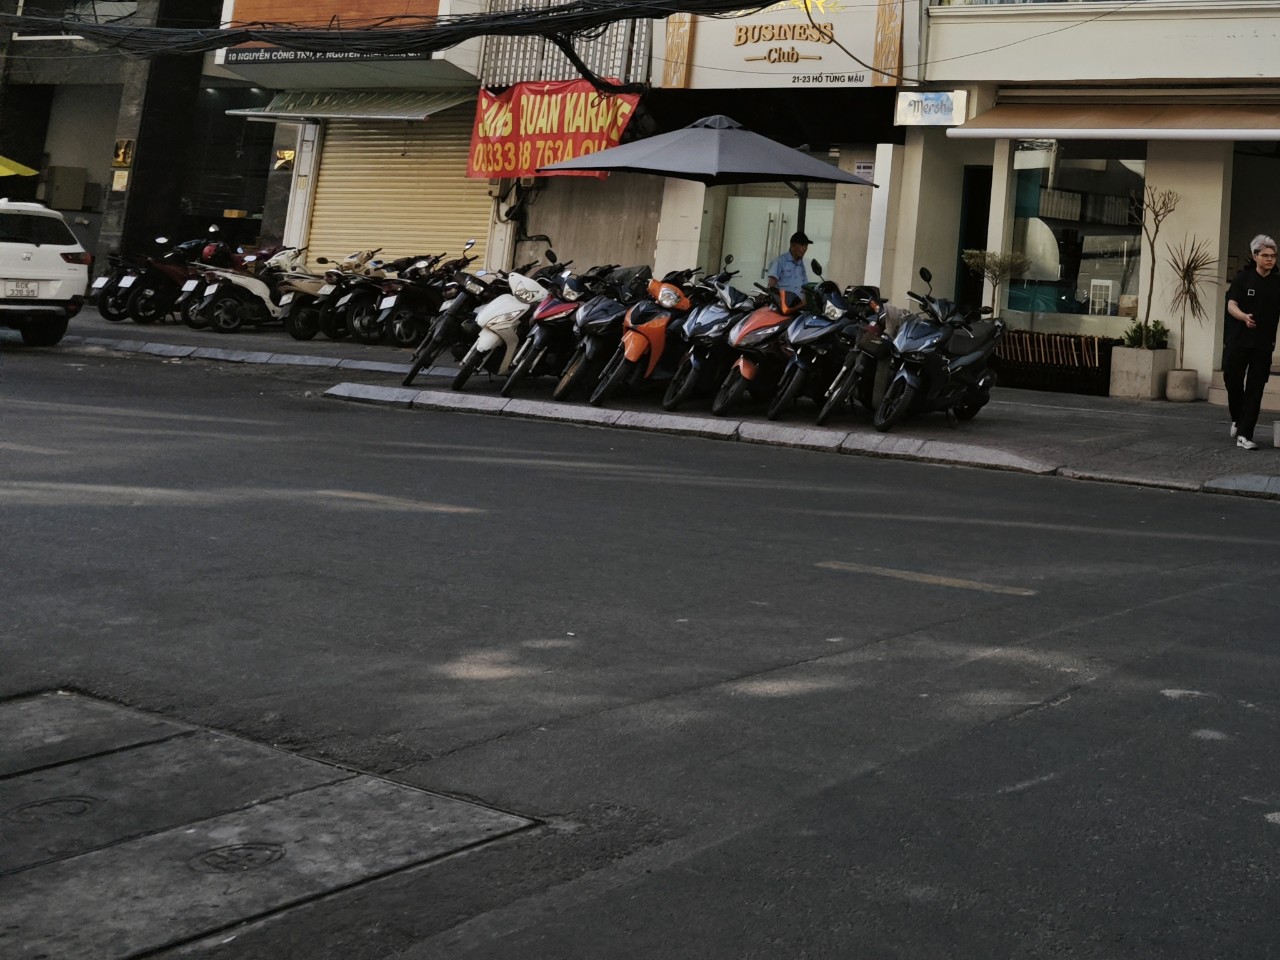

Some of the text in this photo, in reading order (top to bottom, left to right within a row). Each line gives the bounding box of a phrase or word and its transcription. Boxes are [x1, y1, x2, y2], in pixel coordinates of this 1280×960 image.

[734, 22, 835, 47] BUSINESS
[767, 46, 800, 64] Club
[792, 74, 811, 84] 21-23
